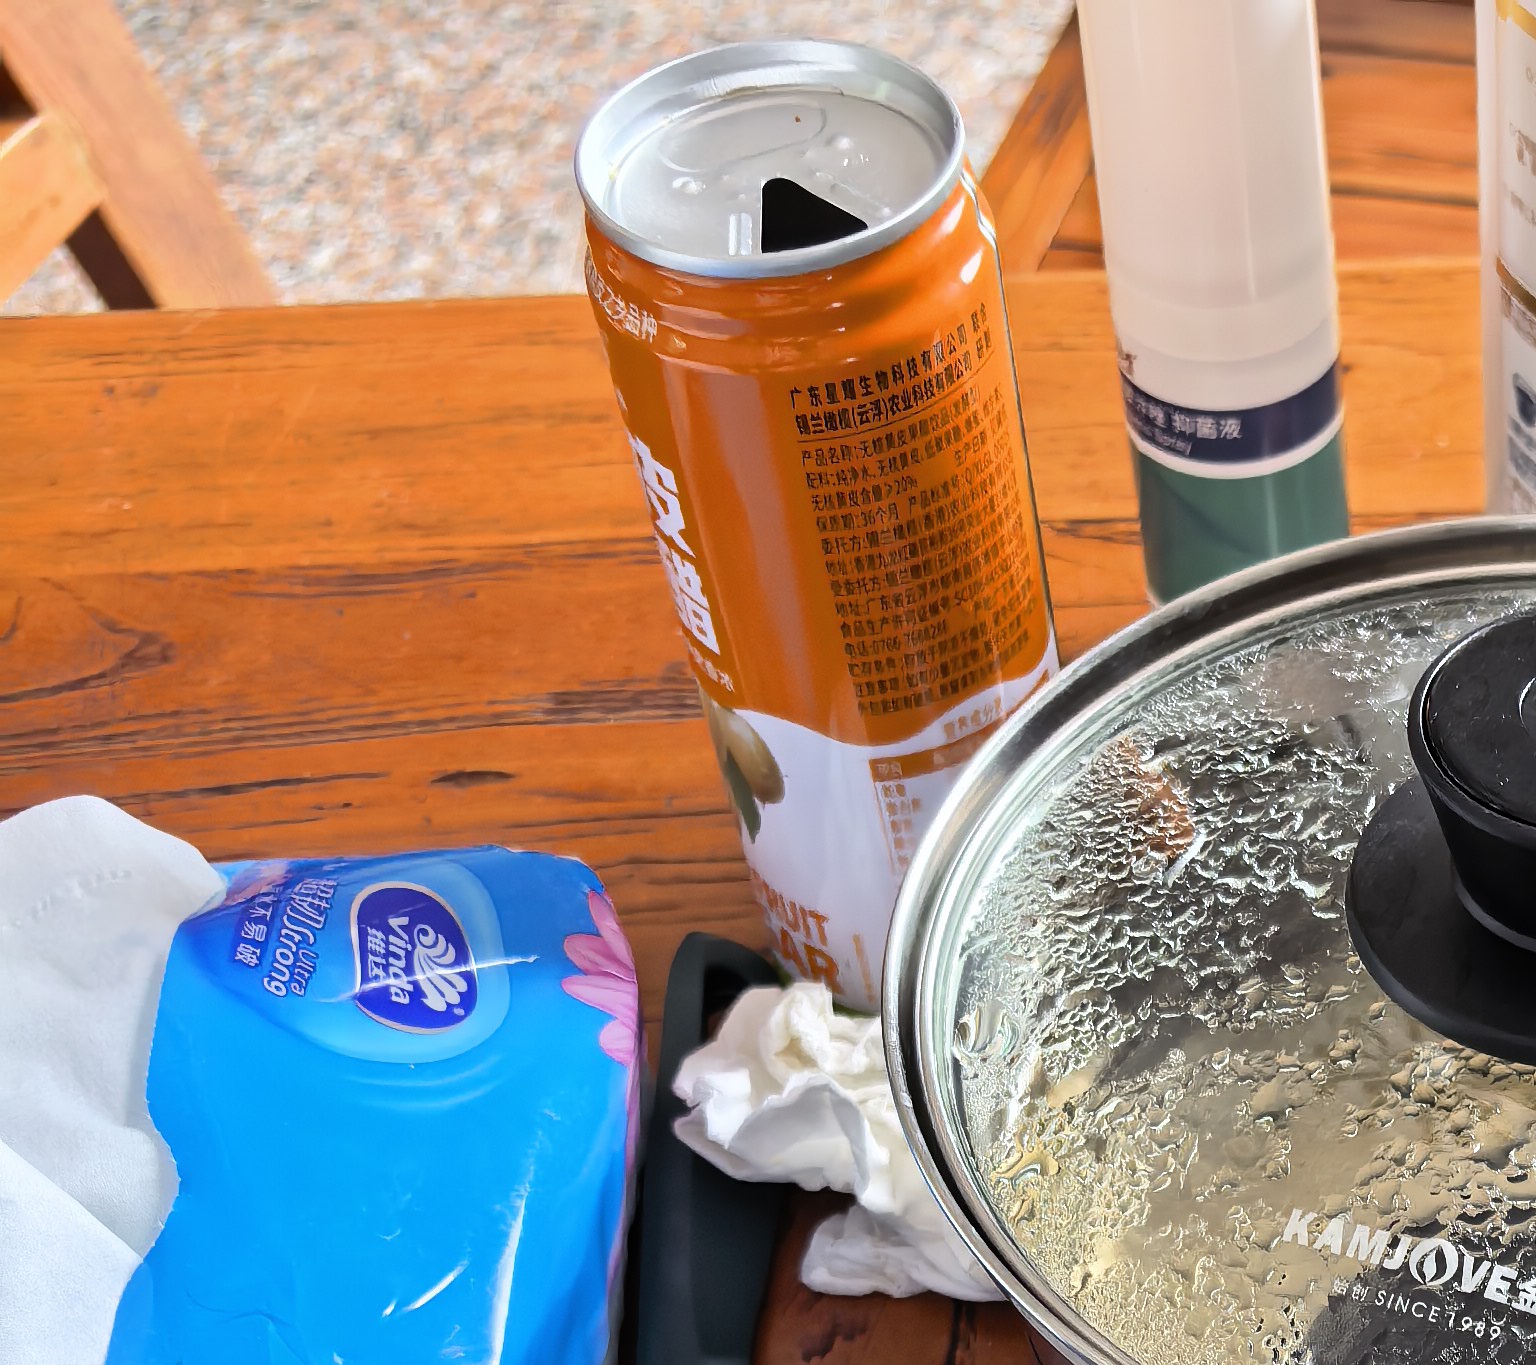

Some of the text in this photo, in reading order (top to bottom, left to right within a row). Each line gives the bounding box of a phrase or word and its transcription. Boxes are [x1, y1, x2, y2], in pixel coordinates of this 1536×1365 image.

[263, 917, 316, 998] Strong
[291, 949, 317, 997] Ultra
[366, 926, 385, 982] 维达
[387, 916, 413, 1005] Vinda
[1375, 1289, 1441, 1323] SINCE
